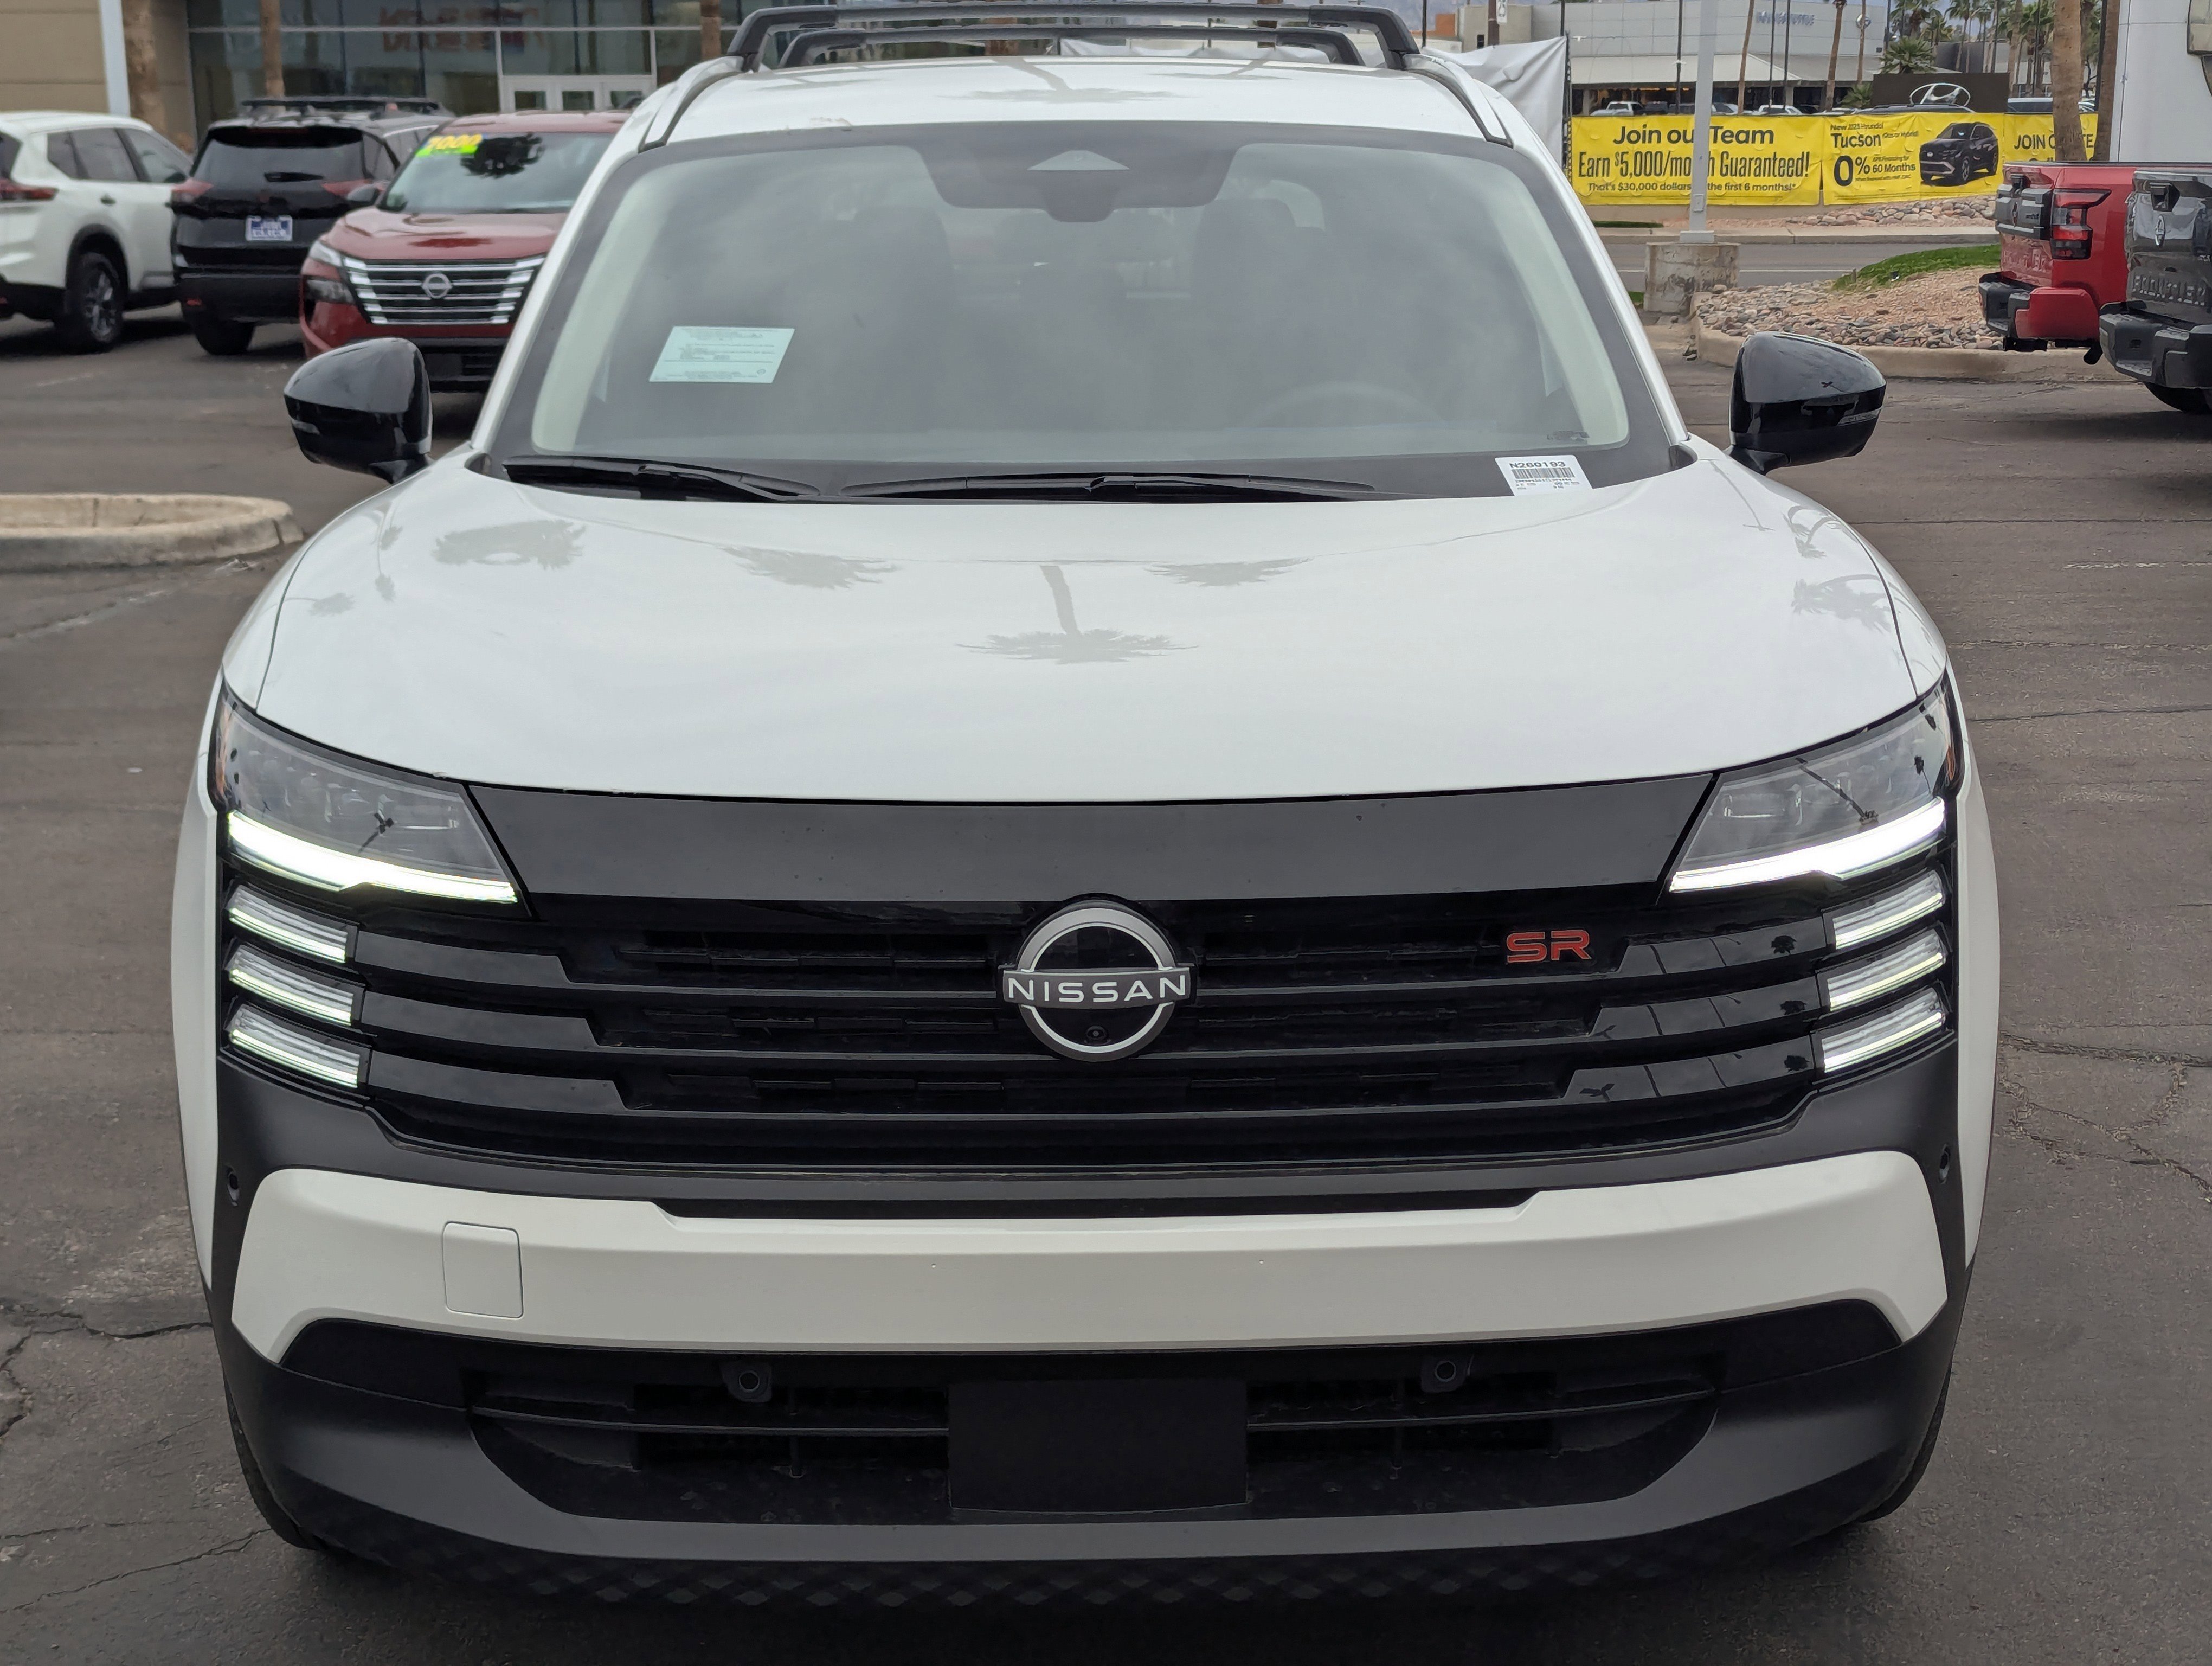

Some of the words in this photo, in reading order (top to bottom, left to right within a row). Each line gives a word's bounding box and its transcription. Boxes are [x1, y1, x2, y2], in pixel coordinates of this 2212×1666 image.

[1613, 124, 1661, 144] Join
[1667, 129, 1694, 144] ou
[1709, 126, 1774, 144] Team
[1830, 133, 1881, 148] Tucson
[2014, 134, 2046, 149] JOIN
[1578, 151, 1610, 177] Earn
[1615, 150, 1715, 178] $5,000/moh
[1720, 151, 1810, 177] Guaranteed!
[1834, 155, 1870, 187] 0%
[1872, 164, 1883, 173] 60
[1884, 162, 1916, 173] Months
[1589, 182, 1616, 191] That's
[1618, 182, 1658, 192] $30,000
[1660, 182, 1692, 190] dollars
[1725, 182, 1741, 190] first
[1506, 929, 1592, 963] SR
[1008, 975, 1186, 1003] NISSAN
